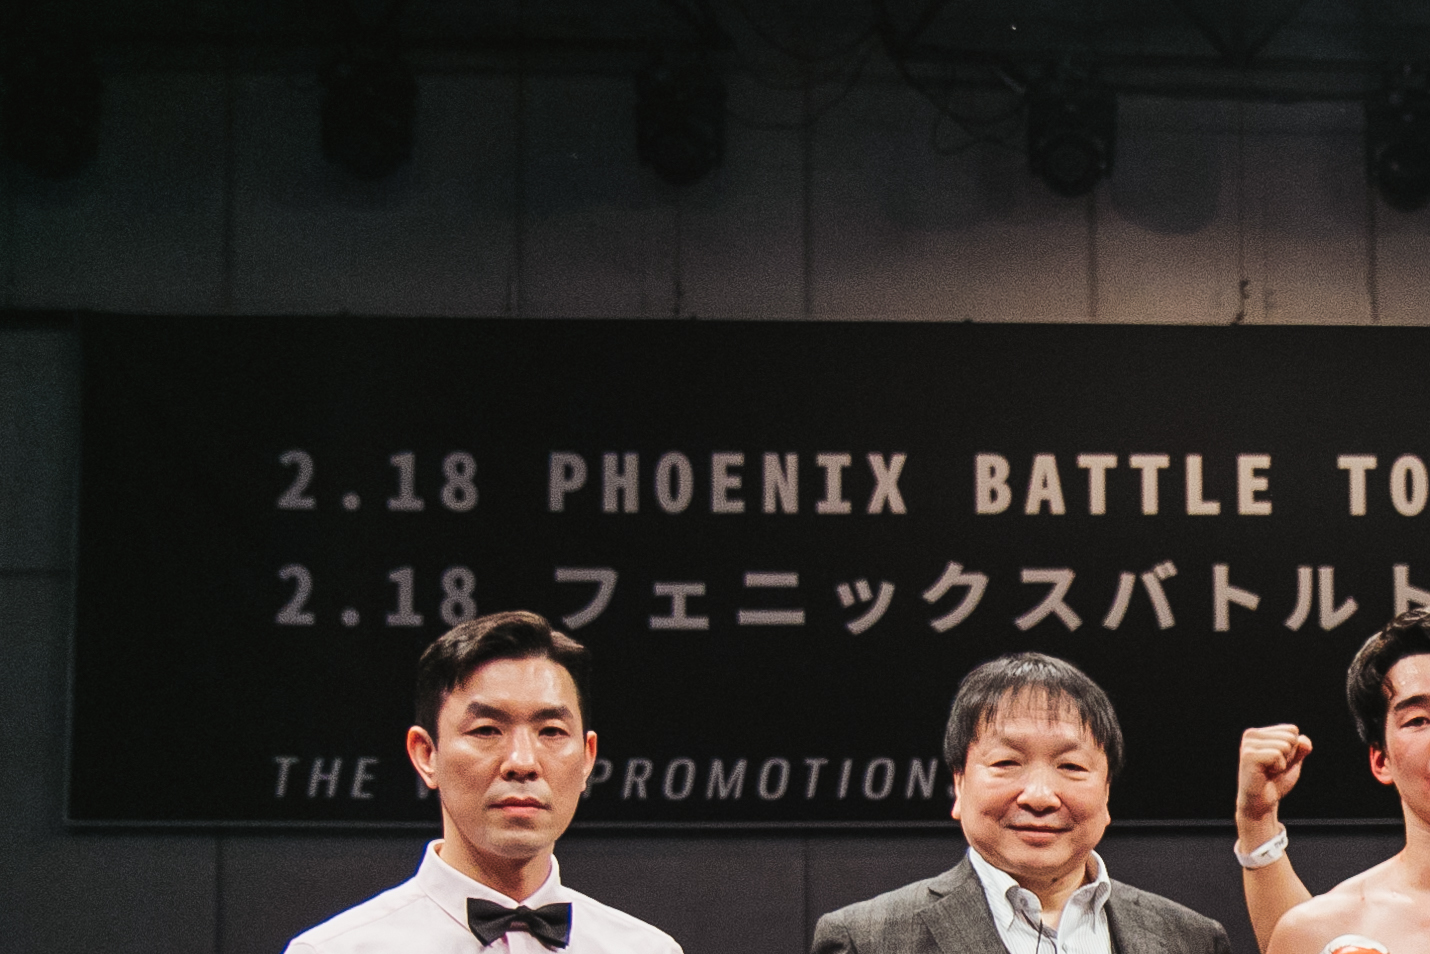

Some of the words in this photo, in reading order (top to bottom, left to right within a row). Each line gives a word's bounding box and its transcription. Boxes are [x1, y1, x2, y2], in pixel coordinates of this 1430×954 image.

[277, 449, 480, 512] 2.18
[549, 452, 908, 515] PHOENIX
[974, 453, 1273, 516] BATTLE
[275, 563, 480, 627] 2.18
[274, 756, 379, 799] THE
[594, 756, 953, 801] PROMOTION
